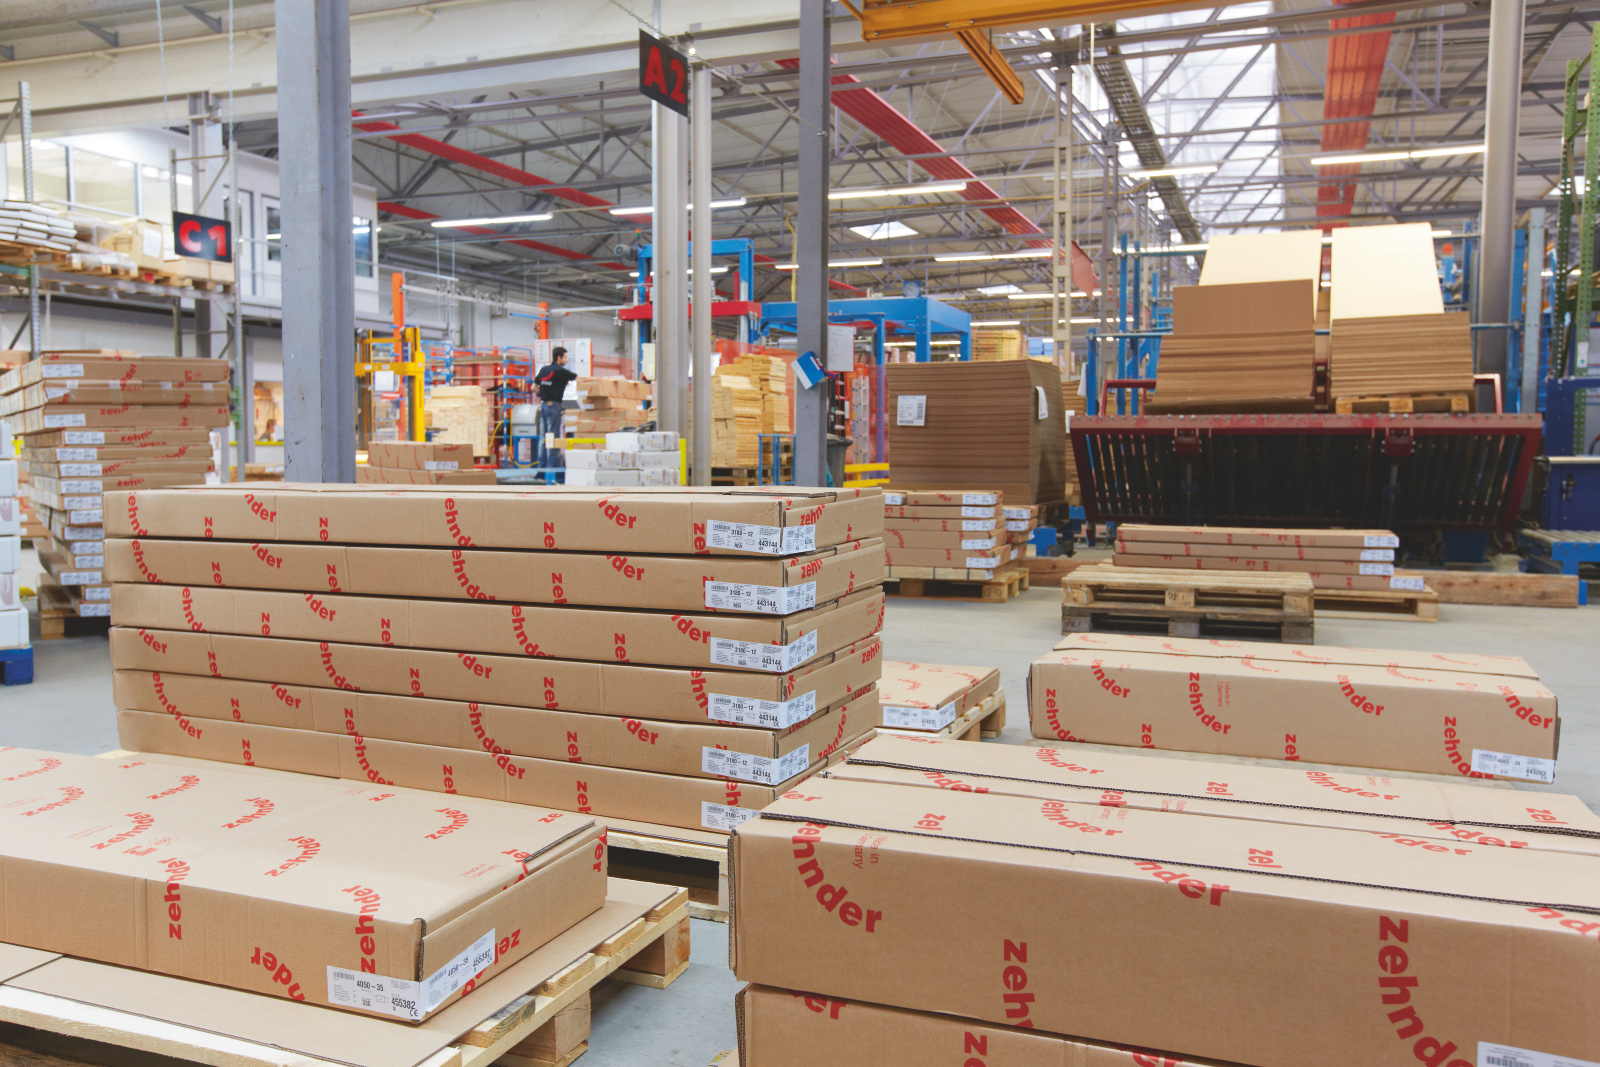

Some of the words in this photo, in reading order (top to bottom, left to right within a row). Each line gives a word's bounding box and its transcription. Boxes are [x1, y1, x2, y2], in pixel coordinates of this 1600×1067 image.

[642, 44, 687, 106] A2
[178, 219, 227, 257] C1
[128, 491, 149, 537] ehnd
[800, 503, 826, 526] zehn
[132, 540, 170, 585] ehnd
[182, 586, 208, 633] ehnd
[860, 640, 881, 665] zehn
[1188, 671, 1232, 735] zehnder
[146, 774, 201, 801] zehnde
[90, 811, 156, 851] zehnder
[220, 796, 276, 830] zehnder
[424, 807, 470, 841] zehnder
[264, 835, 322, 878] zehnder
[157, 856, 192, 941] zehnder
[341, 885, 382, 975] zehnder
[391, 997, 416, 1010] 455382
